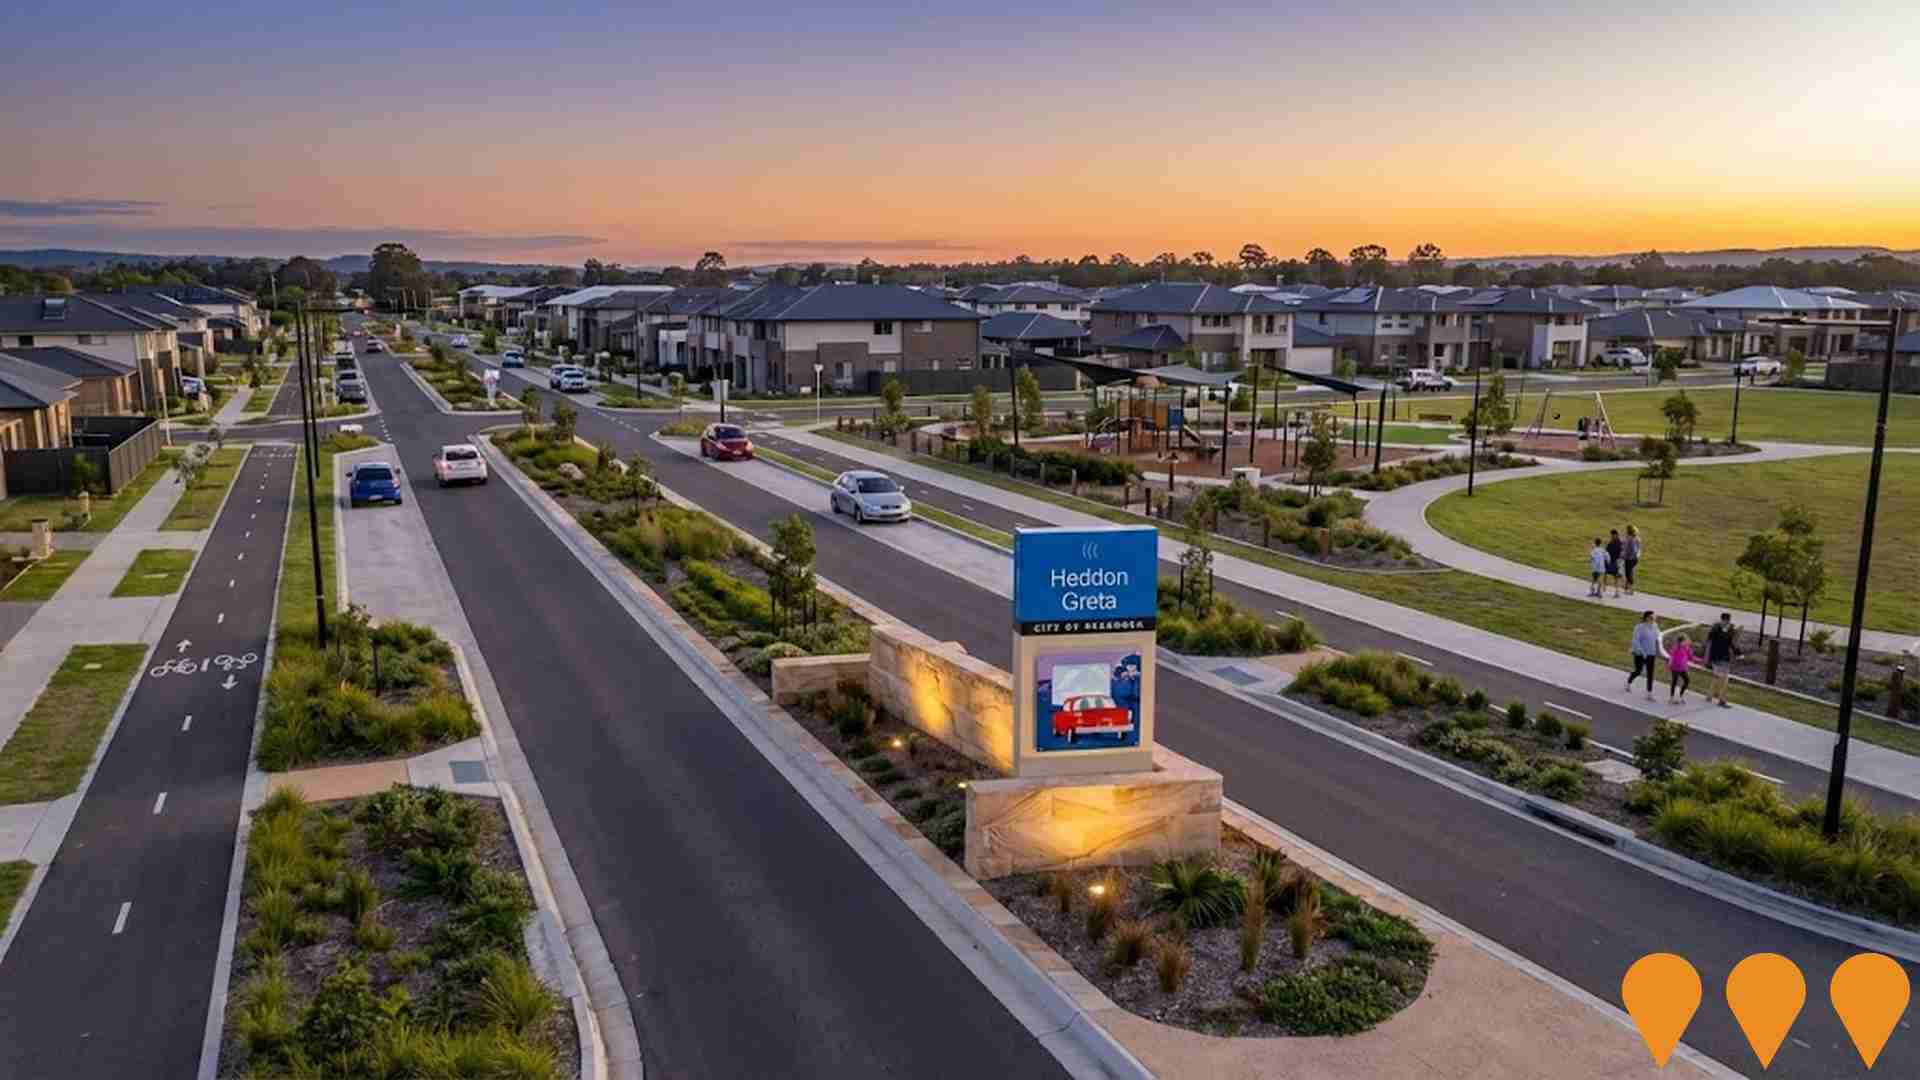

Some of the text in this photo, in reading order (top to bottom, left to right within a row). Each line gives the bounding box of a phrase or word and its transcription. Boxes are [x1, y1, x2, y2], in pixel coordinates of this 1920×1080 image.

[1051, 568, 1128, 587] Heddon
[1062, 591, 1117, 610] Greta
[1033, 623, 1060, 633] CITY
